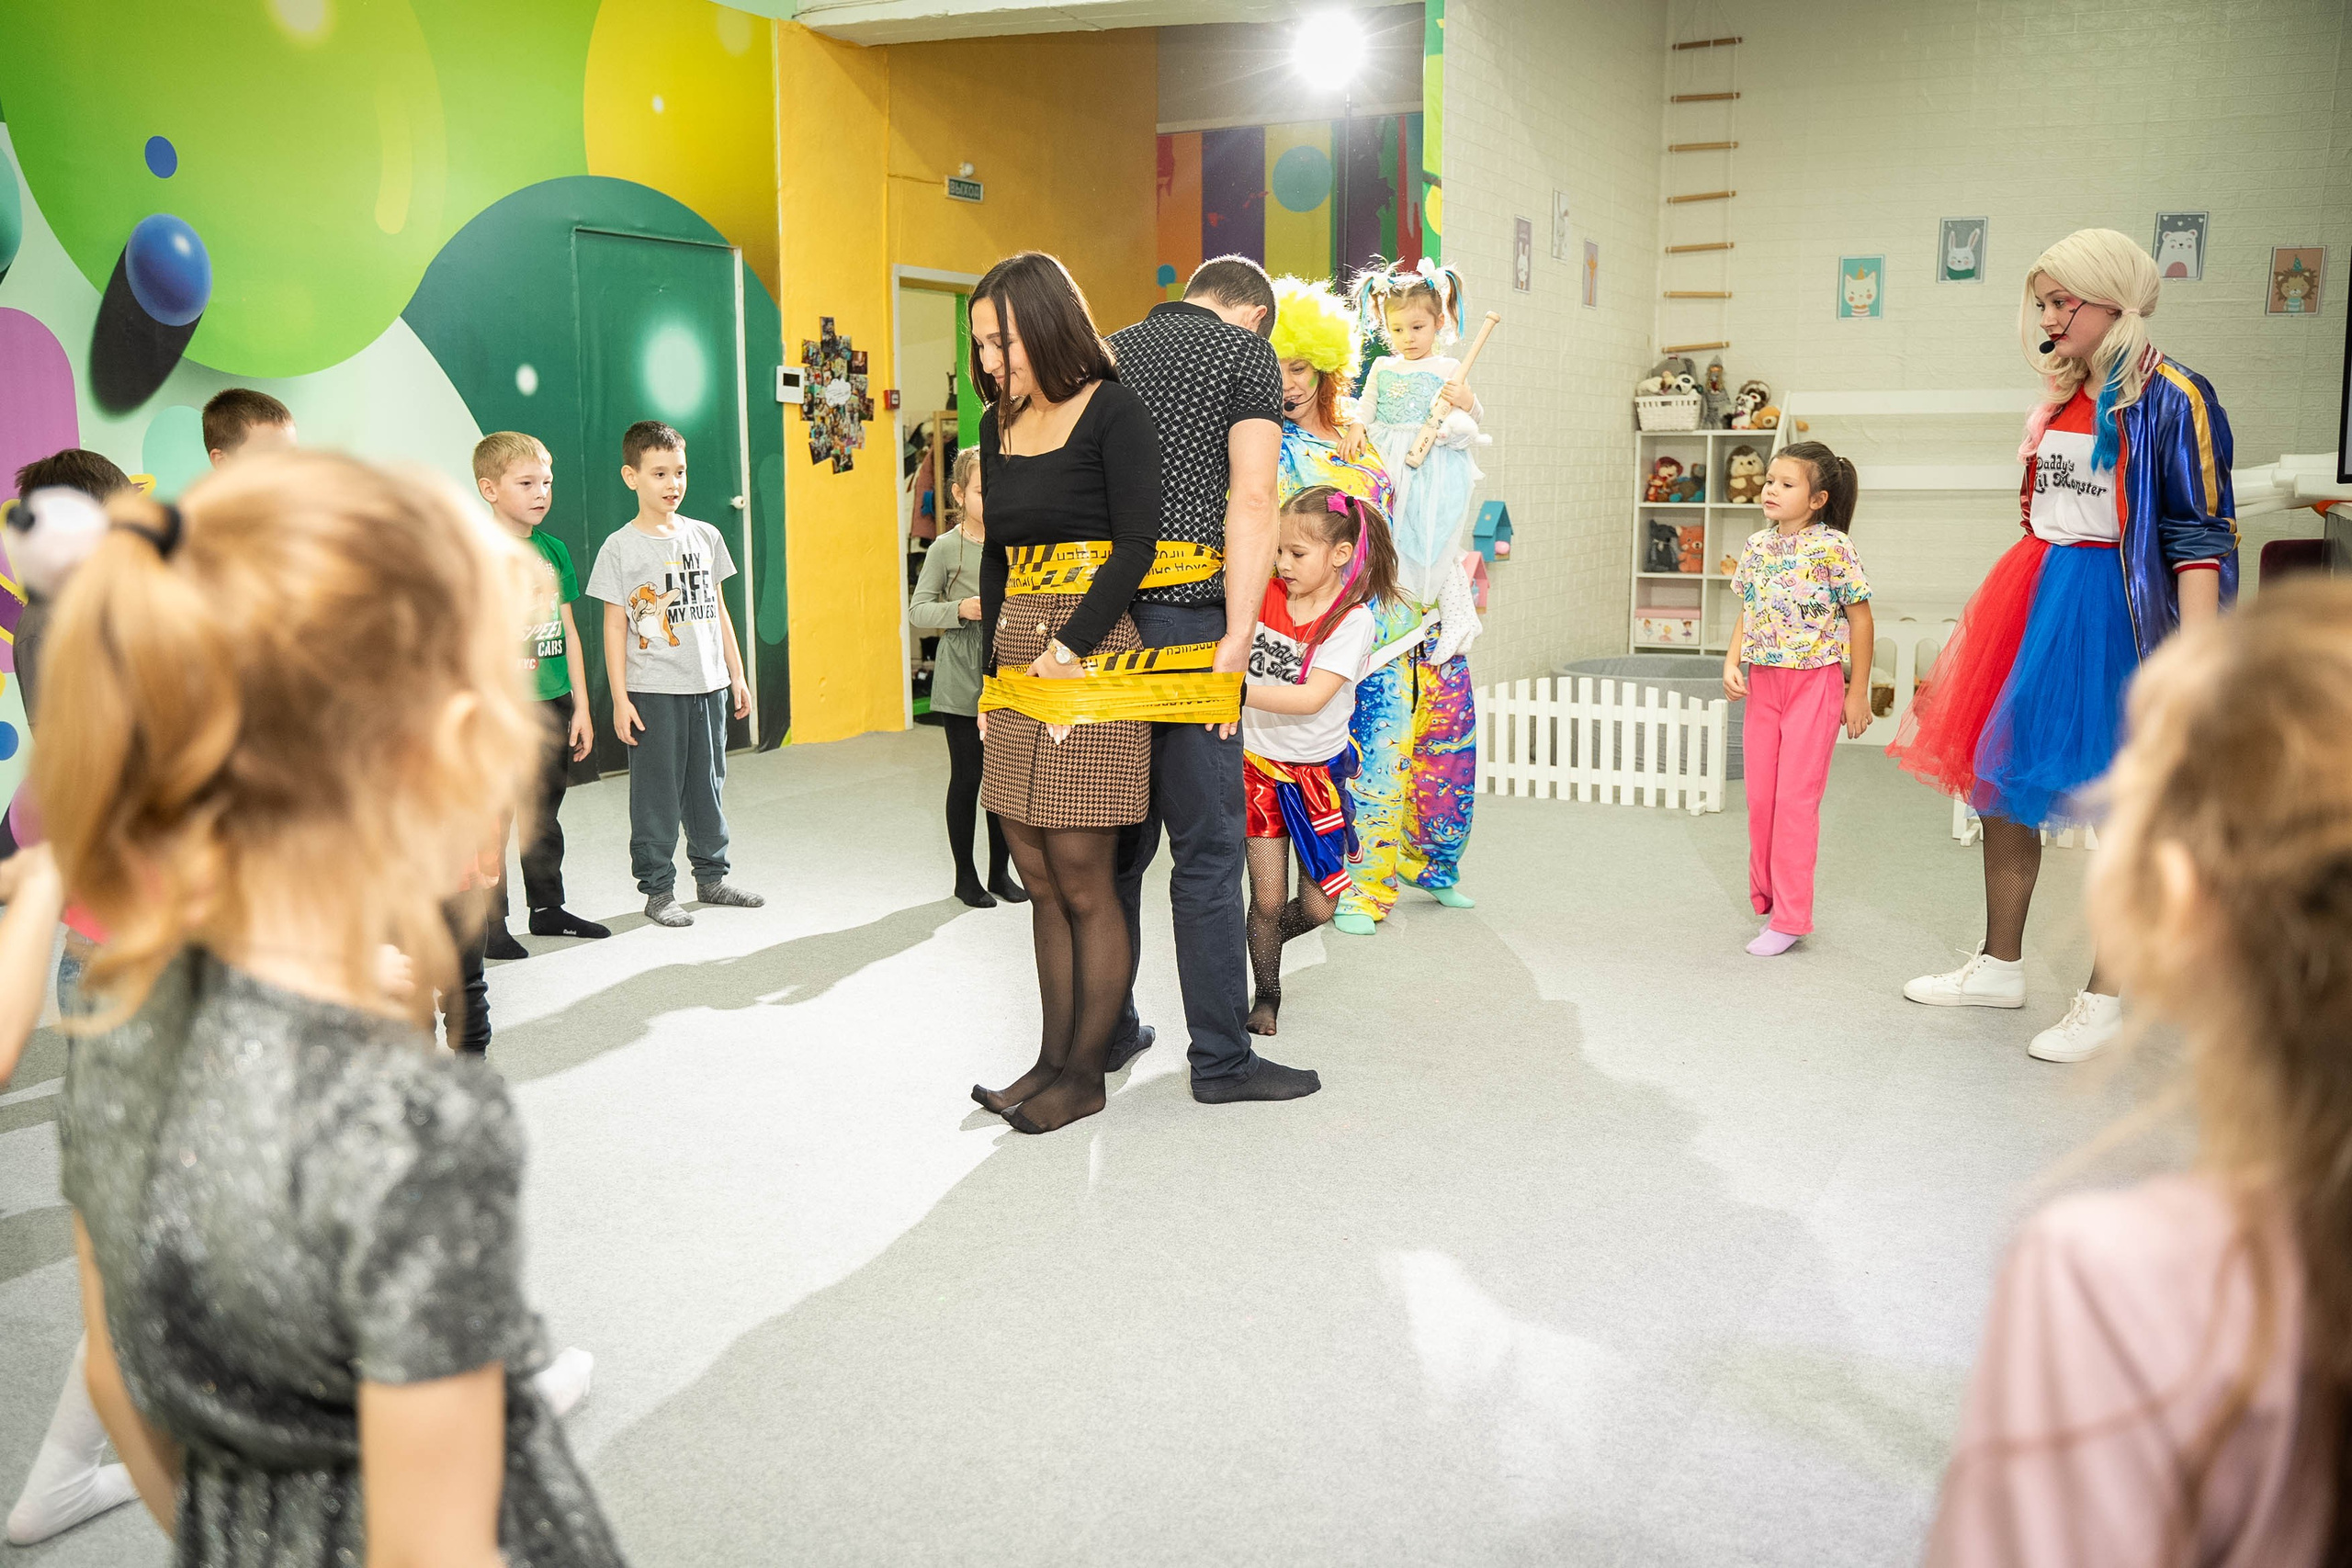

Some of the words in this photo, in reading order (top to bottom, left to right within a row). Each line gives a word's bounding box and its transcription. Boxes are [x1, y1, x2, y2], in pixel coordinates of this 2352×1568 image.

[950, 181, 979, 198] ВЫХОД
[2036, 454, 2075, 474] Daddy's
[2052, 473, 2108, 496] Monster
[682, 553, 700, 570] MY
[668, 608, 685, 624] MY
[537, 639, 562, 657] CARS
